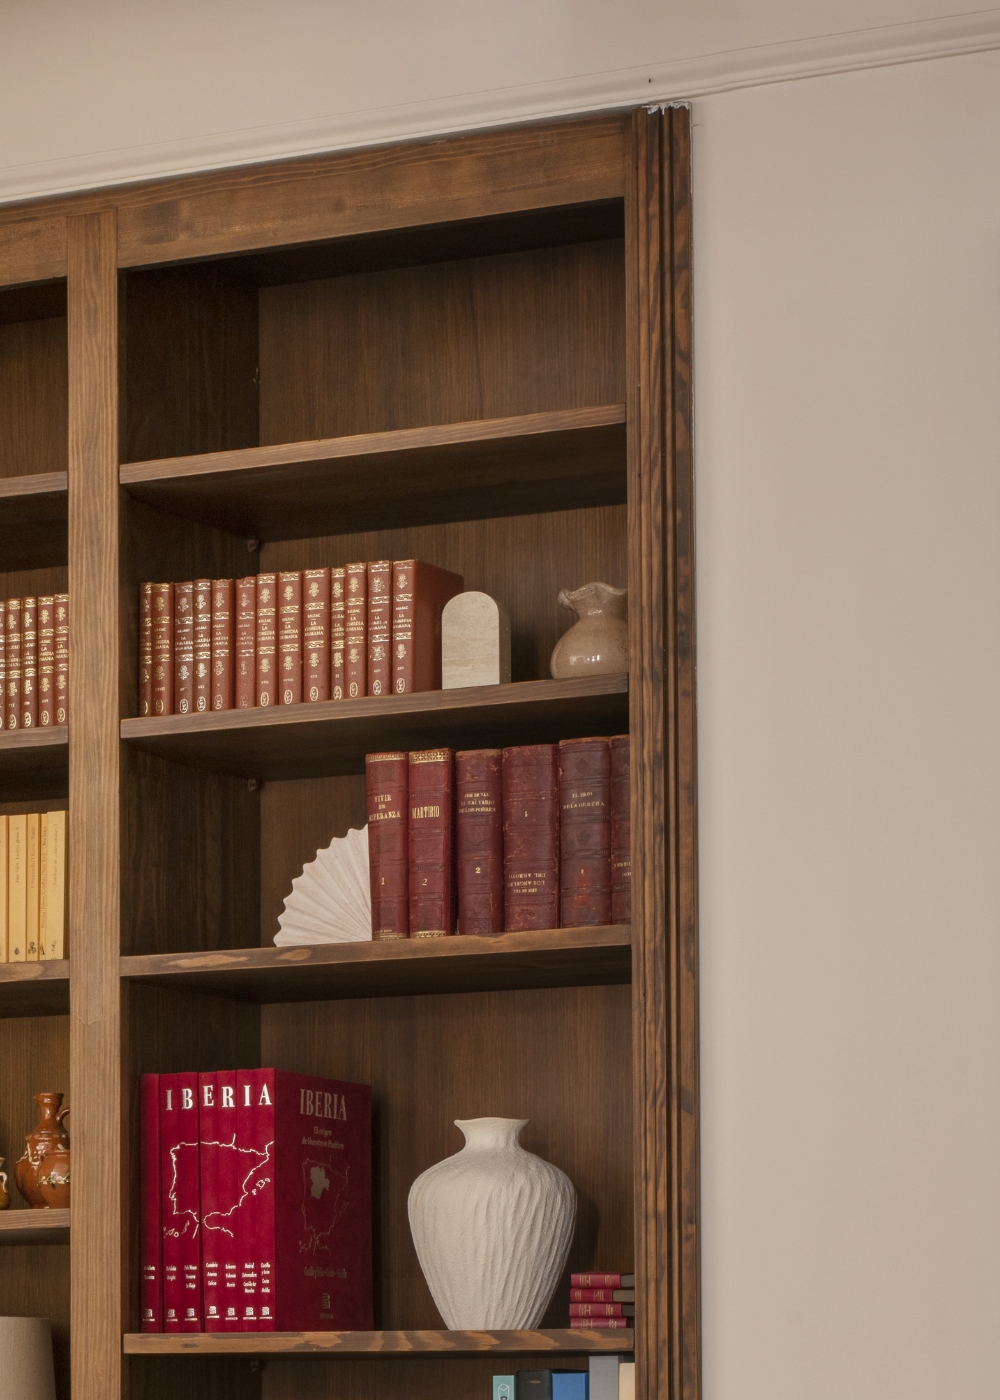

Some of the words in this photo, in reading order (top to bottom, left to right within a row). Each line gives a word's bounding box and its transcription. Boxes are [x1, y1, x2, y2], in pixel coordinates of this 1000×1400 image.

[374, 794, 392, 802] VIVIR
[412, 806, 440, 819] MARTIRIO
[475, 866, 480, 874] 2
[422, 878, 428, 886] 2
[165, 1084, 272, 1111] IBERIA
[300, 1088, 347, 1121] IBERIA
[307, 1137, 327, 1148] Nuestros
